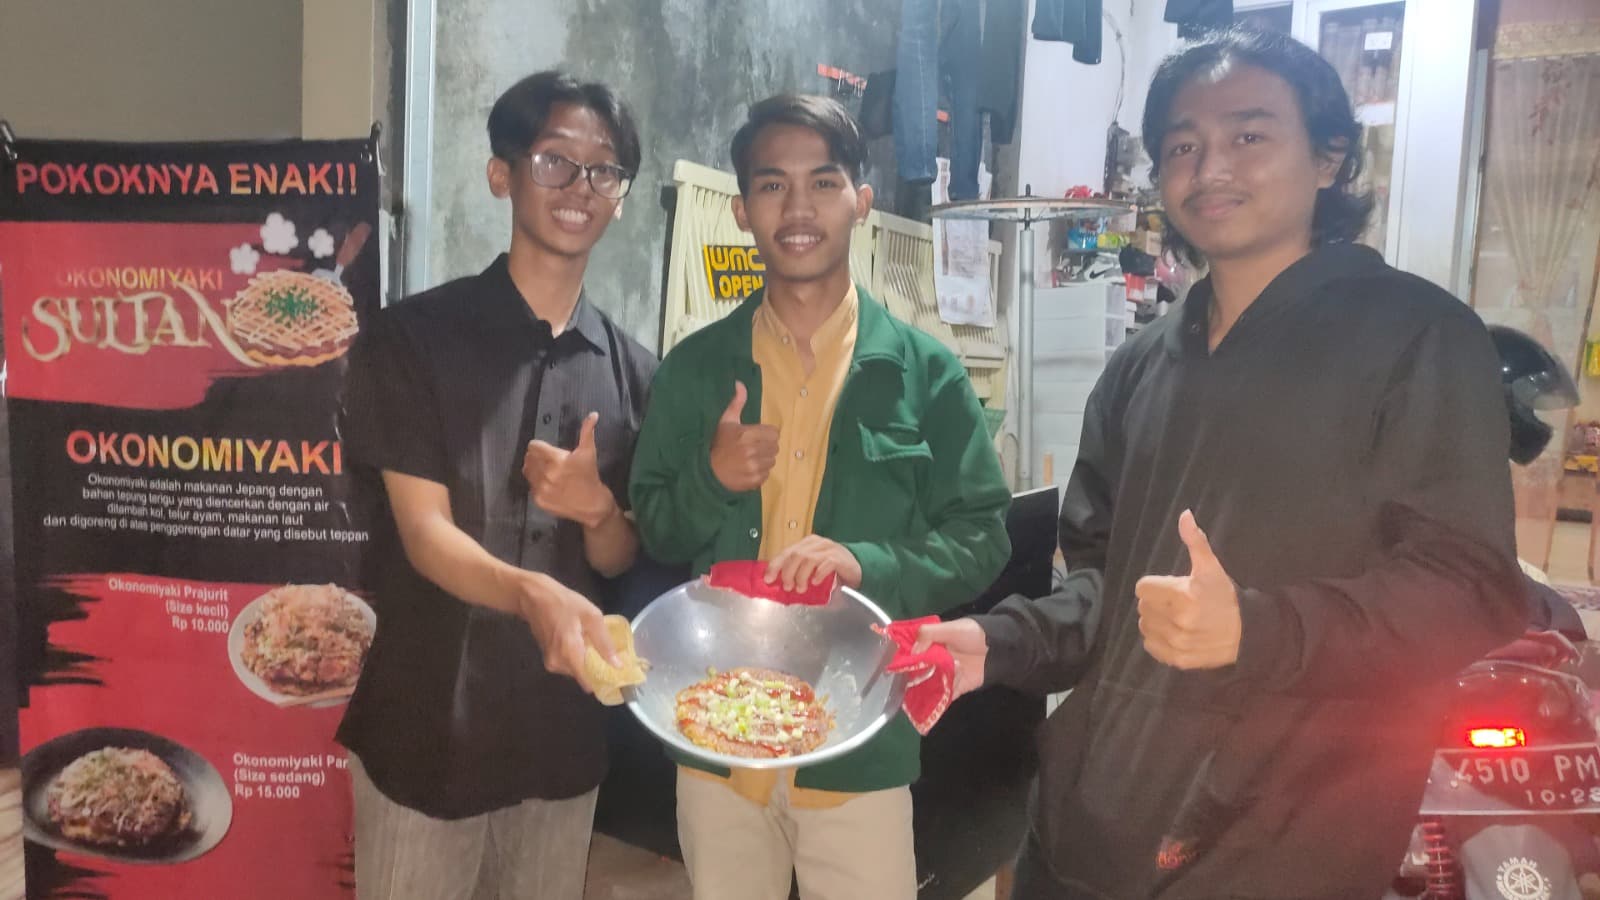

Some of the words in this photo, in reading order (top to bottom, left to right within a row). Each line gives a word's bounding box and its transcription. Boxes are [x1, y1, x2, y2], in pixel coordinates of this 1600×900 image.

[16, 163, 218, 194] POKOKNYA
[228, 163, 357, 195] ENAK!!
[57, 266, 223, 290] OKONOMIYAKI
[719, 275, 763, 298] OPEN
[22, 284, 266, 368] SULTAN
[66, 430, 343, 475] OKONOMIYAKI
[87, 472, 148, 489] Okonomiyaki
[149, 478, 181, 492] adalah
[184, 481, 233, 495] makanan
[235, 482, 276, 498] Jepang
[279, 484, 323, 499] dengan
[82, 487, 115, 500] bahan
[117, 489, 147, 506] tepung
[177, 496, 203, 509] yang
[205, 496, 265, 510] diencerkan
[267, 499, 311, 513] dengan
[314, 501, 330, 512] air
[43, 515, 67, 527] dan
[70, 514, 117, 530] digoreng
[119, 517, 128, 528] di
[150, 521, 221, 538] penggorengan
[223, 524, 251, 537] datar
[253, 528, 281, 542] yang
[283, 527, 327, 541] disebut
[330, 529, 369, 543] teppan
[168, 508, 190, 521] telur
[192, 511, 225, 524] ayam,
[228, 512, 279, 525] makanan
[281, 514, 304, 526] laut
[108, 577, 181, 598] Okonomiyaki
[184, 584, 228, 603] Prajurit
[165, 599, 193, 615] (Size
[196, 602, 229, 620] kecil)
[171, 615, 188, 632] Rp
[191, 617, 229, 634] 10.000
[233, 752, 322, 771] Okonomiyaki
[1455, 757, 1530, 785] 4510
[1553, 753, 1600, 782] PM
[233, 767, 266, 783] (Size
[270, 769, 325, 786] sedang)
[234, 783, 253, 799] Rp
[257, 784, 300, 798] 15.000
